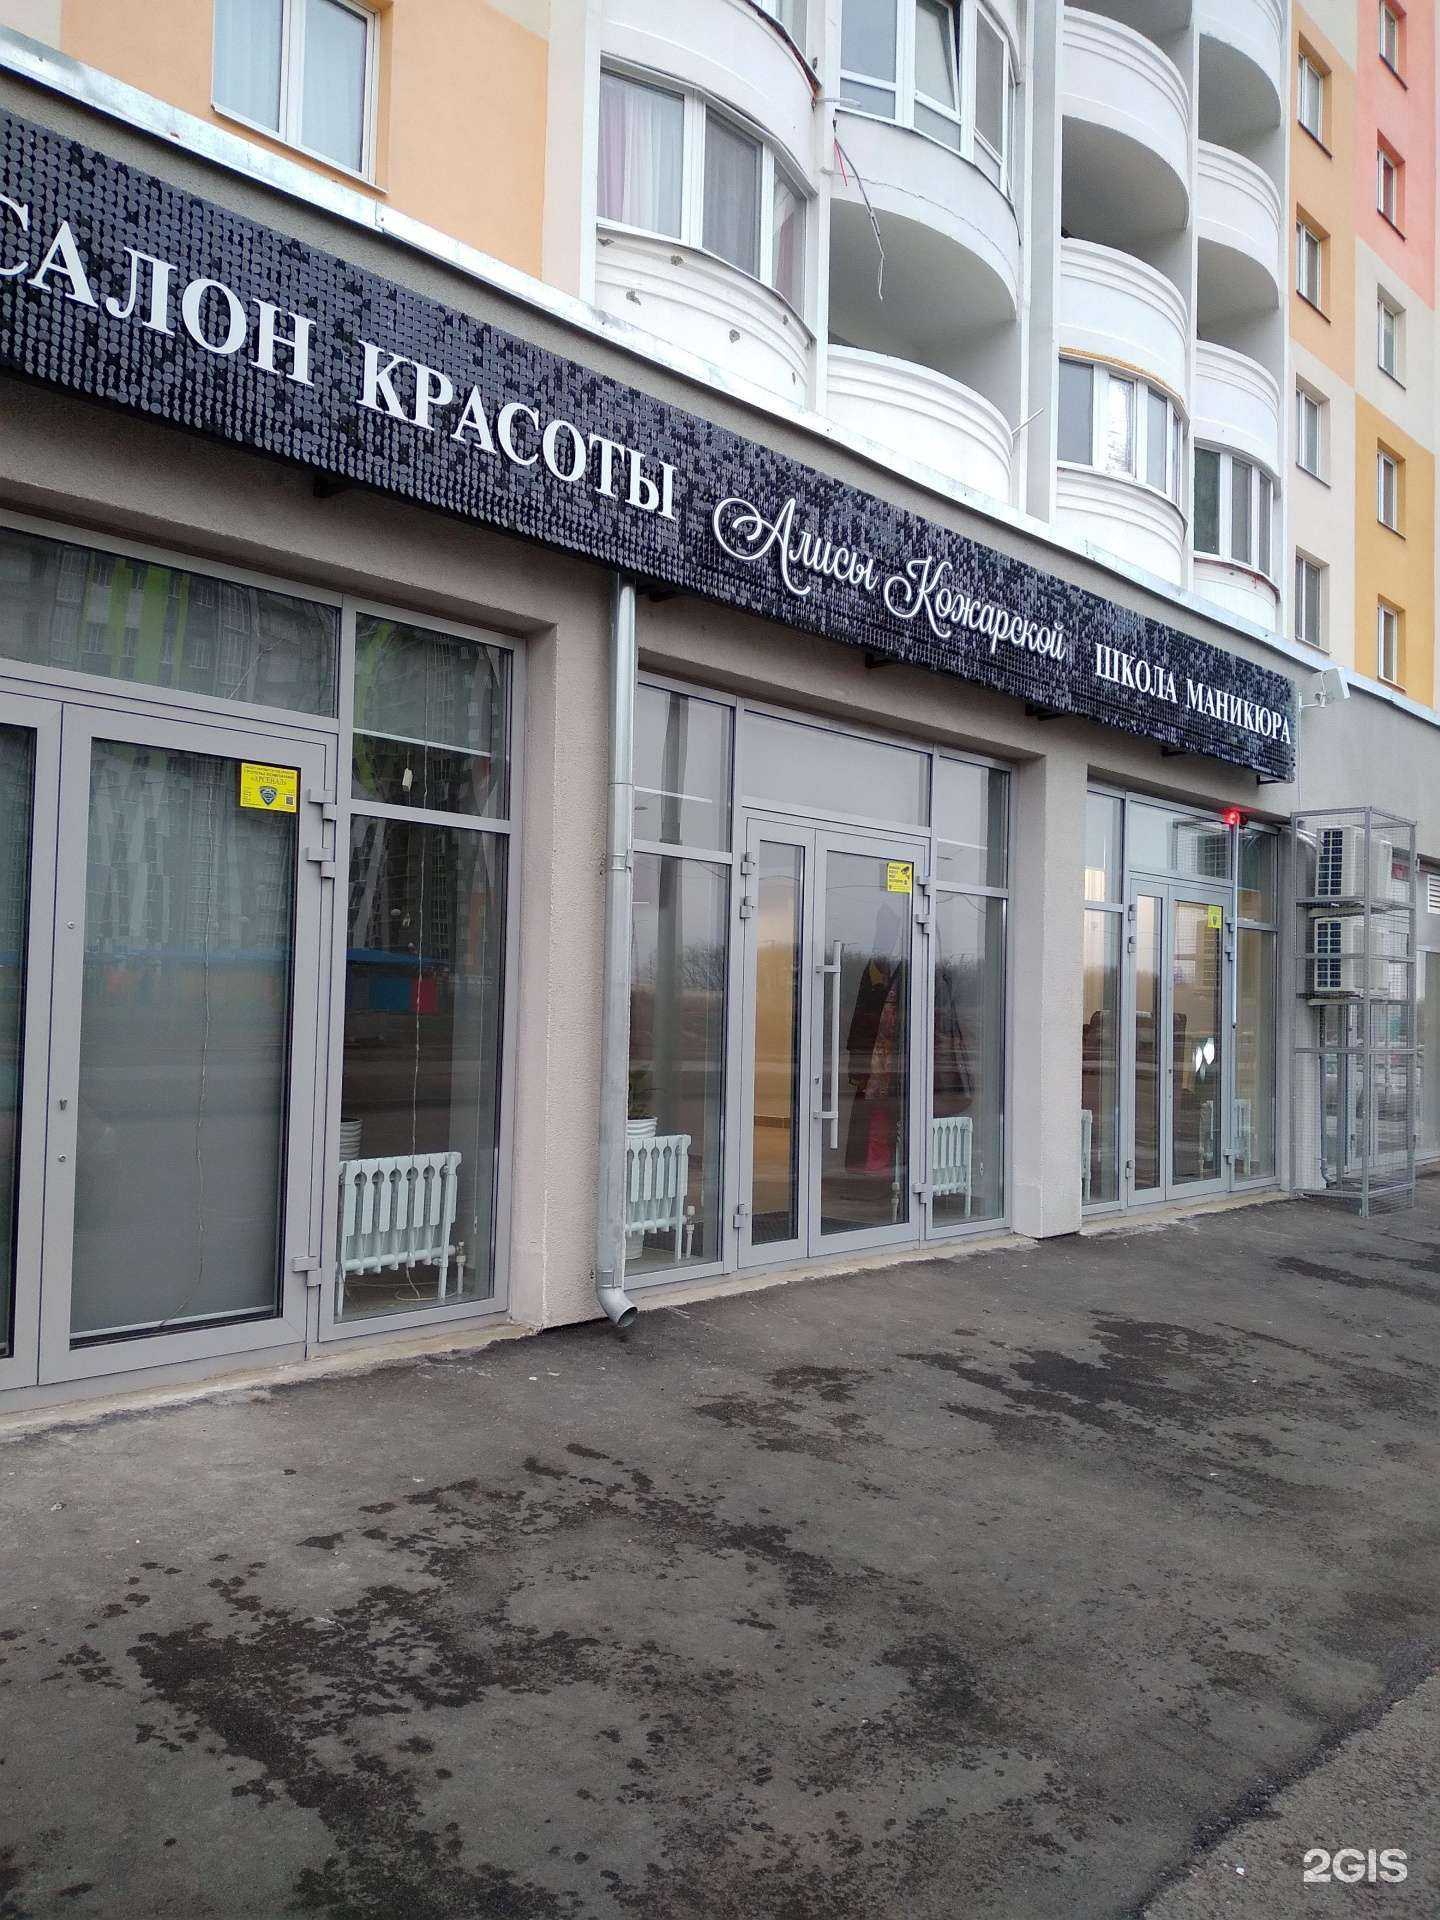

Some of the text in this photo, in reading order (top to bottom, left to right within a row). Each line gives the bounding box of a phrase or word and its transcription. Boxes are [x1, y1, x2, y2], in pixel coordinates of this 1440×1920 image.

[356, 340, 679, 521] КРАСОТЫ
[712, 497, 880, 596] Алисы
[883, 554, 1068, 661] Кожарской
[1095, 642, 1291, 745] ШКОЛА МАНИКЮРА
